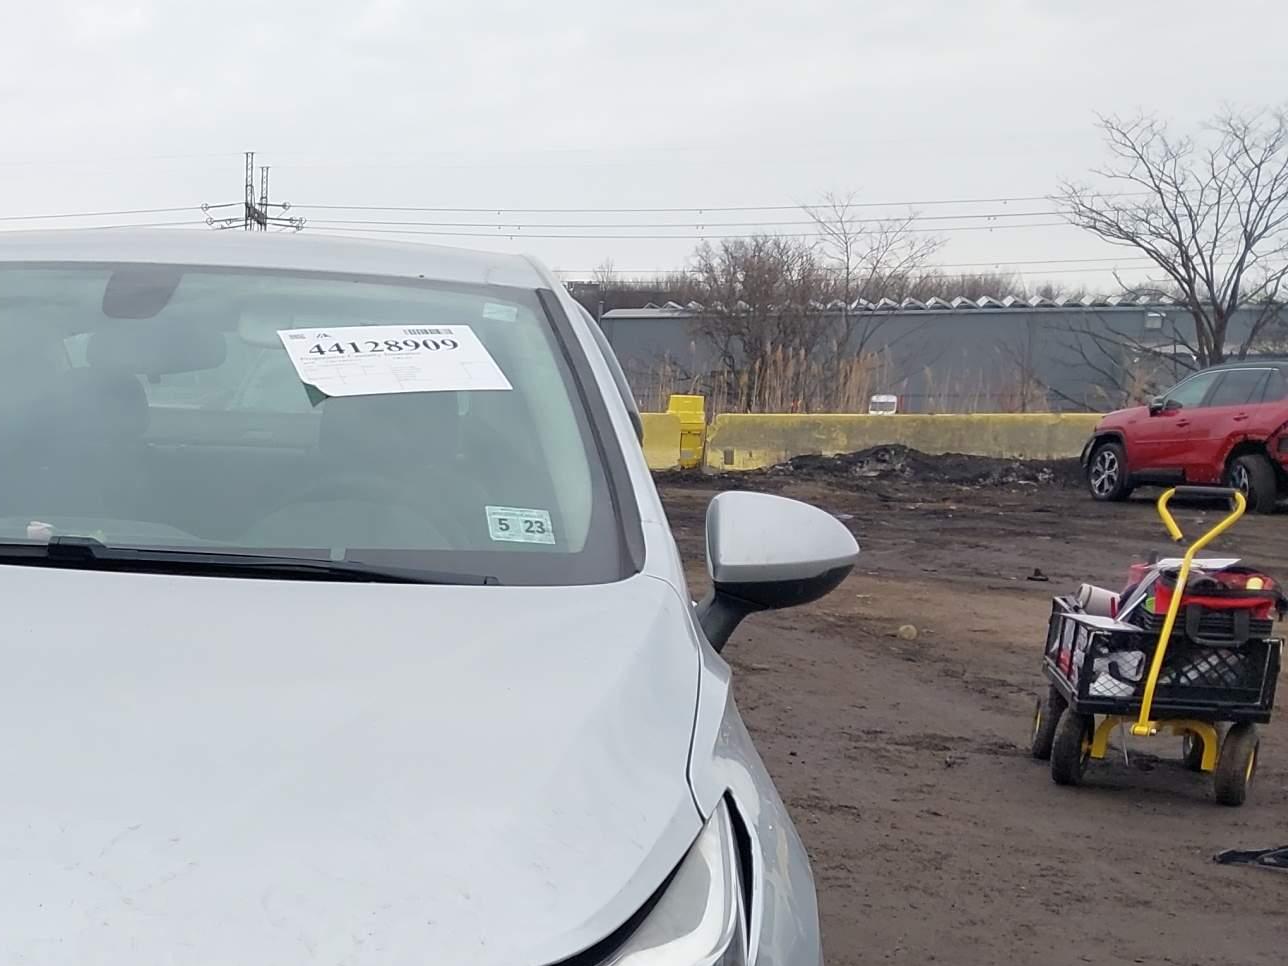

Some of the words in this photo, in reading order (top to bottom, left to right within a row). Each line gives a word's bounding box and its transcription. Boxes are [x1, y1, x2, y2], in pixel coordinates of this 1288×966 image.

[309, 338, 459, 356] 44128909
[498, 518, 510, 532] 5
[524, 519, 546, 534] 23
